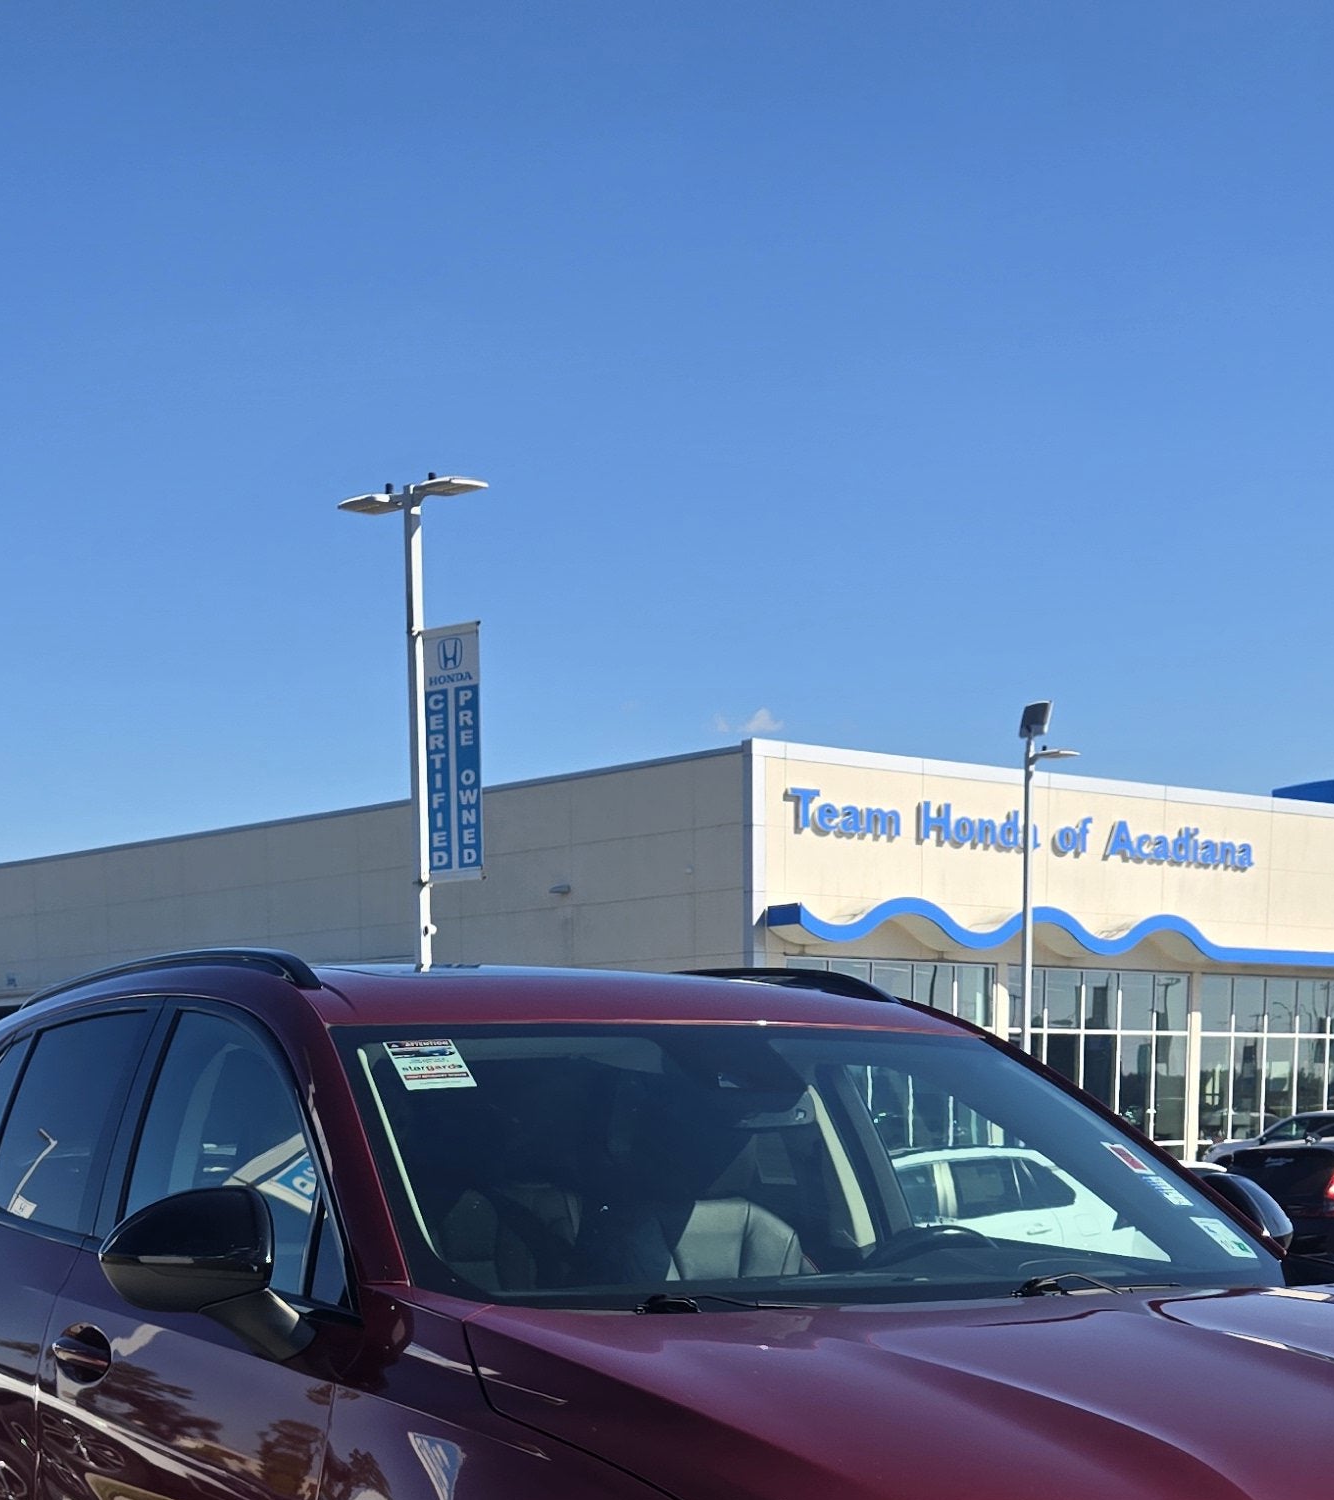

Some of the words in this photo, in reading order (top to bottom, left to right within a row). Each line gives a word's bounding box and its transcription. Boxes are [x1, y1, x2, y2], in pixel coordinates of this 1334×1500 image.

[428, 671, 473, 686] HONDA
[457, 689, 475, 746] PRE
[428, 694, 449, 867] CERTIFIED
[458, 769, 478, 864] OWNED
[786, 787, 902, 840] Team
[1056, 816, 1094, 855] of
[1107, 820, 1255, 869] Acadiana
